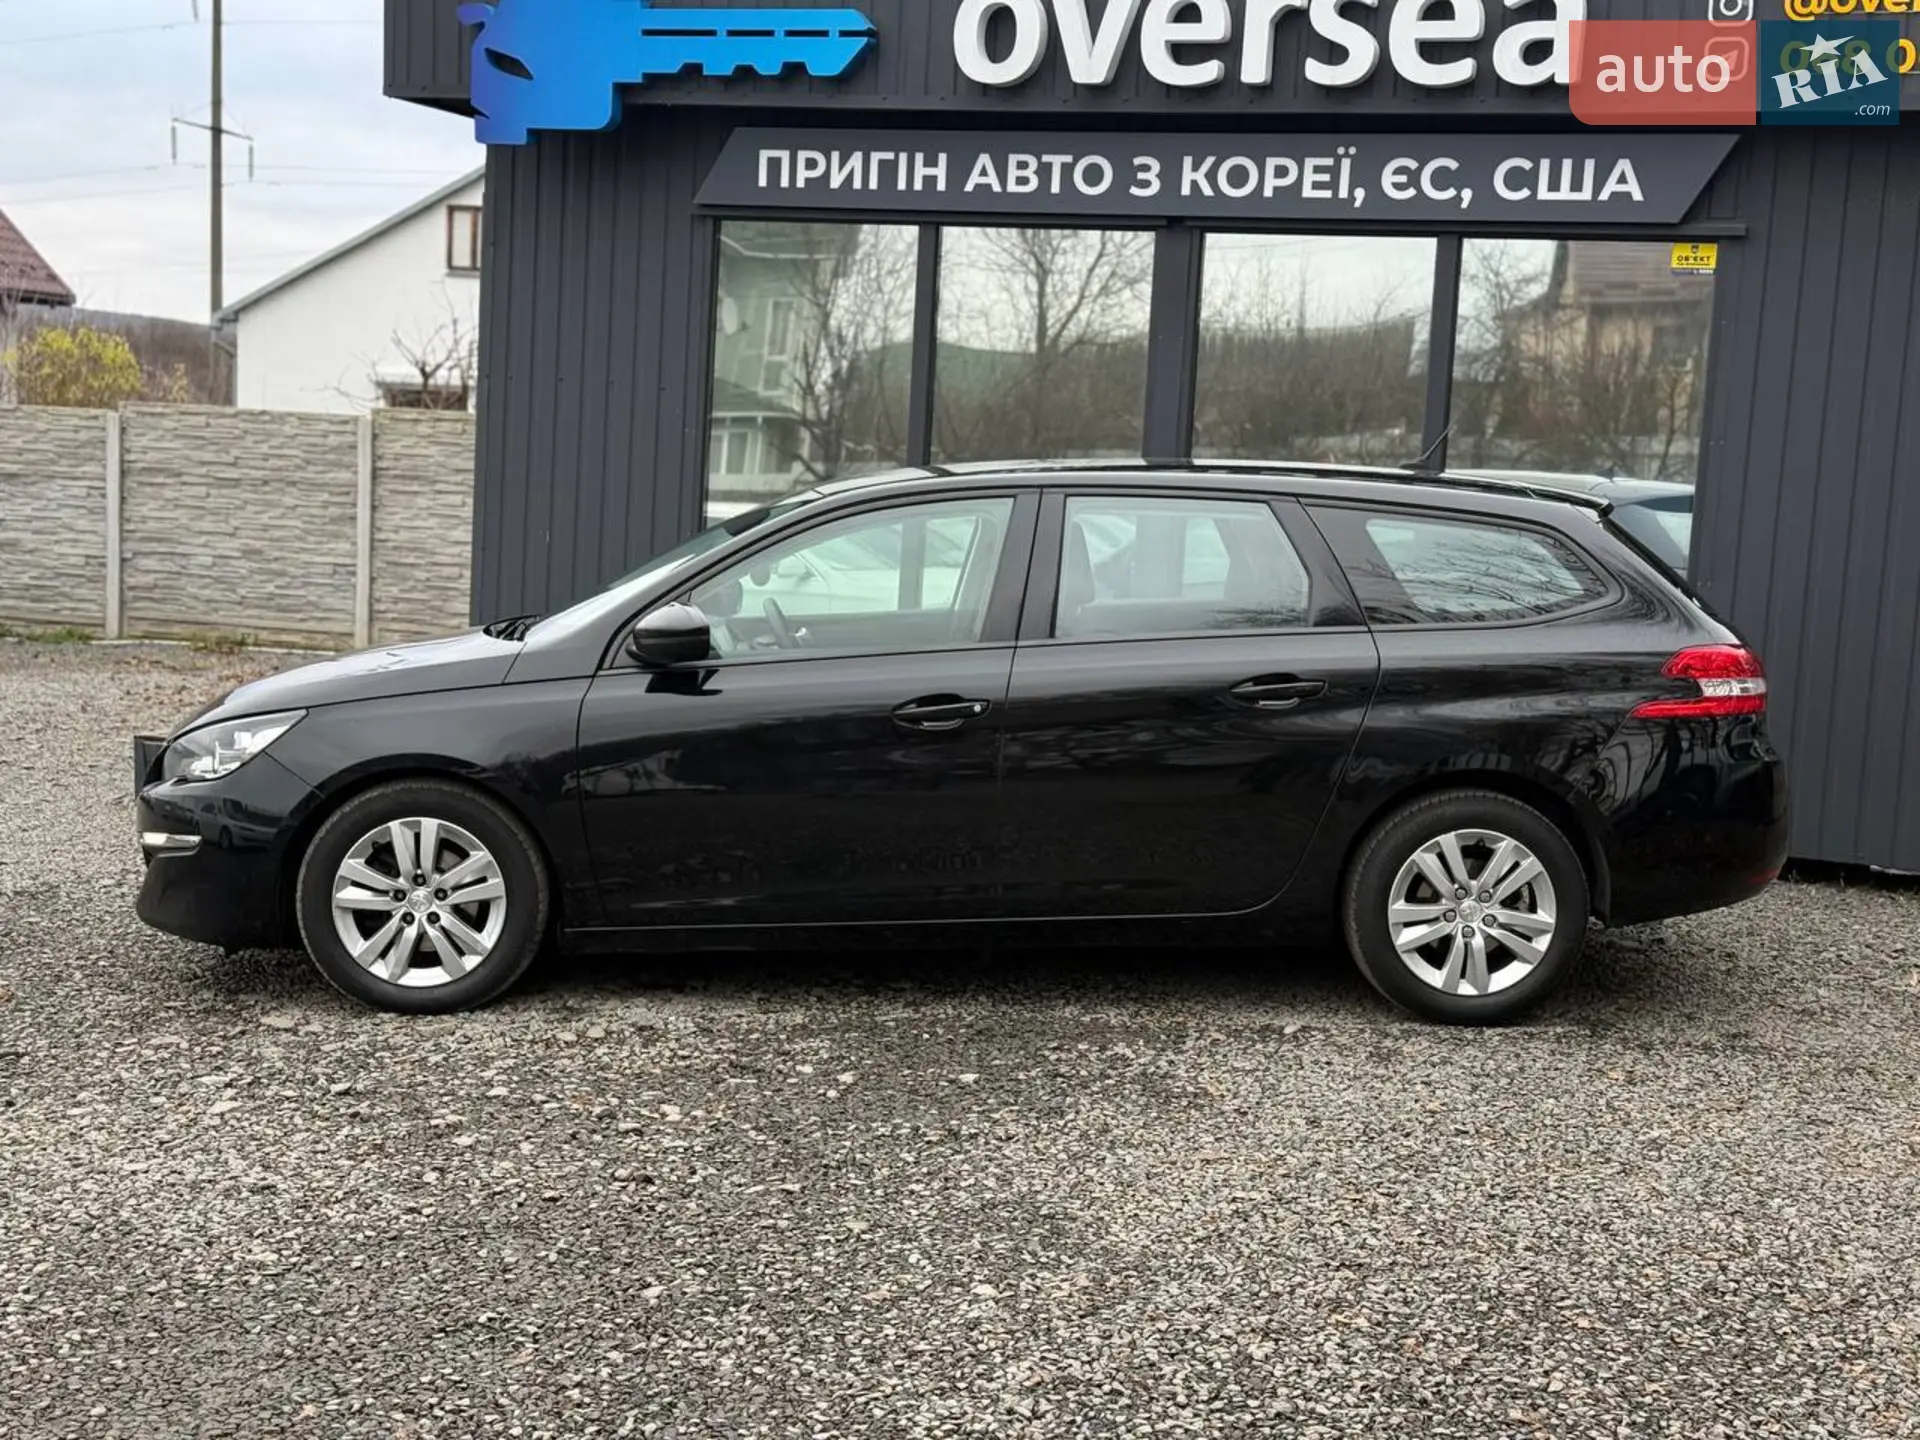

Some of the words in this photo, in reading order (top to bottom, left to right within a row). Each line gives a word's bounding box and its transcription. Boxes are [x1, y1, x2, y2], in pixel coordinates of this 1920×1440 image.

[1784, 0, 1920, 21] @ove
[953, 0, 1587, 87] oversea
[757, 148, 948, 191] ПРИГІН
[963, 152, 1114, 196] АВТО
[1180, 146, 1366, 208] КОРЕЇ,
[1380, 156, 1474, 208] ЄС,
[1492, 157, 1645, 202] США
